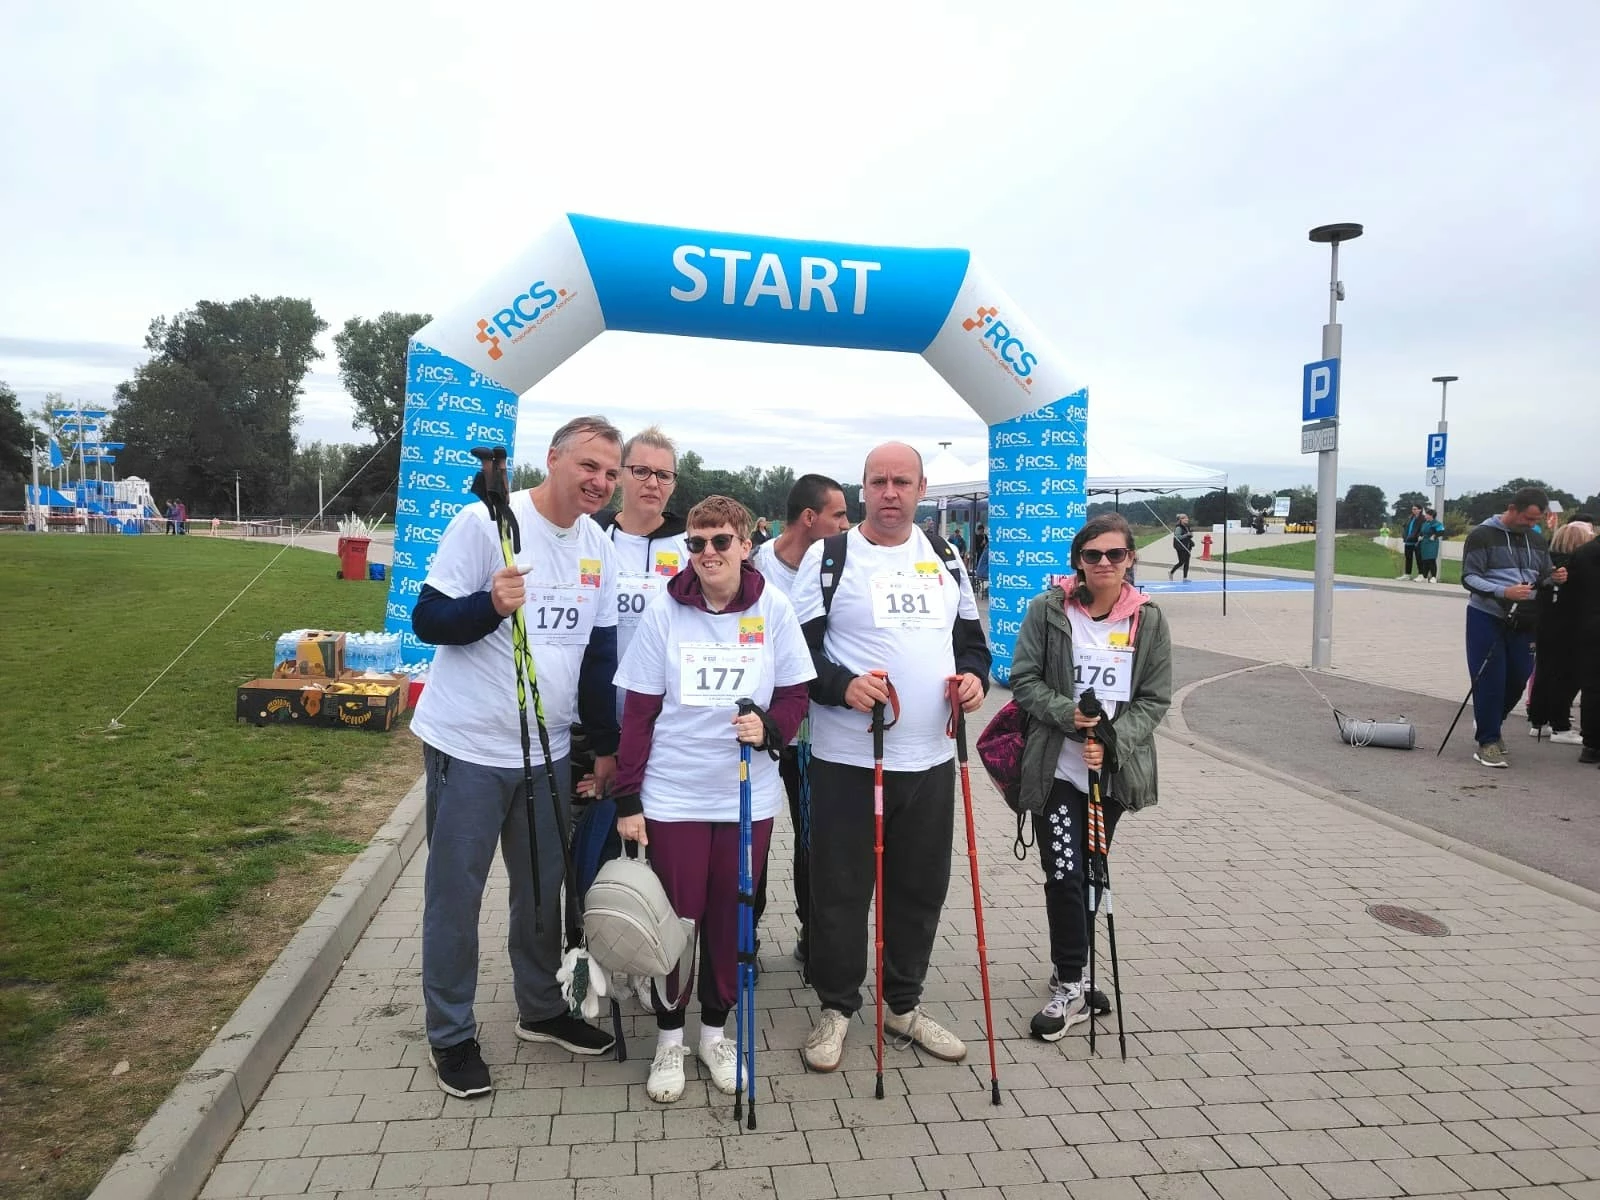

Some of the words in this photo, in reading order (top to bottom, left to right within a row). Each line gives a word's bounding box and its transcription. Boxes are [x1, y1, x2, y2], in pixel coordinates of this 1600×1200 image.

[670, 244, 882, 315] START
[1310, 366, 1330, 413] P
[1431, 436, 1443, 458] P
[616, 593, 645, 614] 80
[886, 593, 931, 614] 181
[537, 606, 579, 630] 179
[696, 667, 745, 691] 177
[1073, 665, 1117, 687] 176
